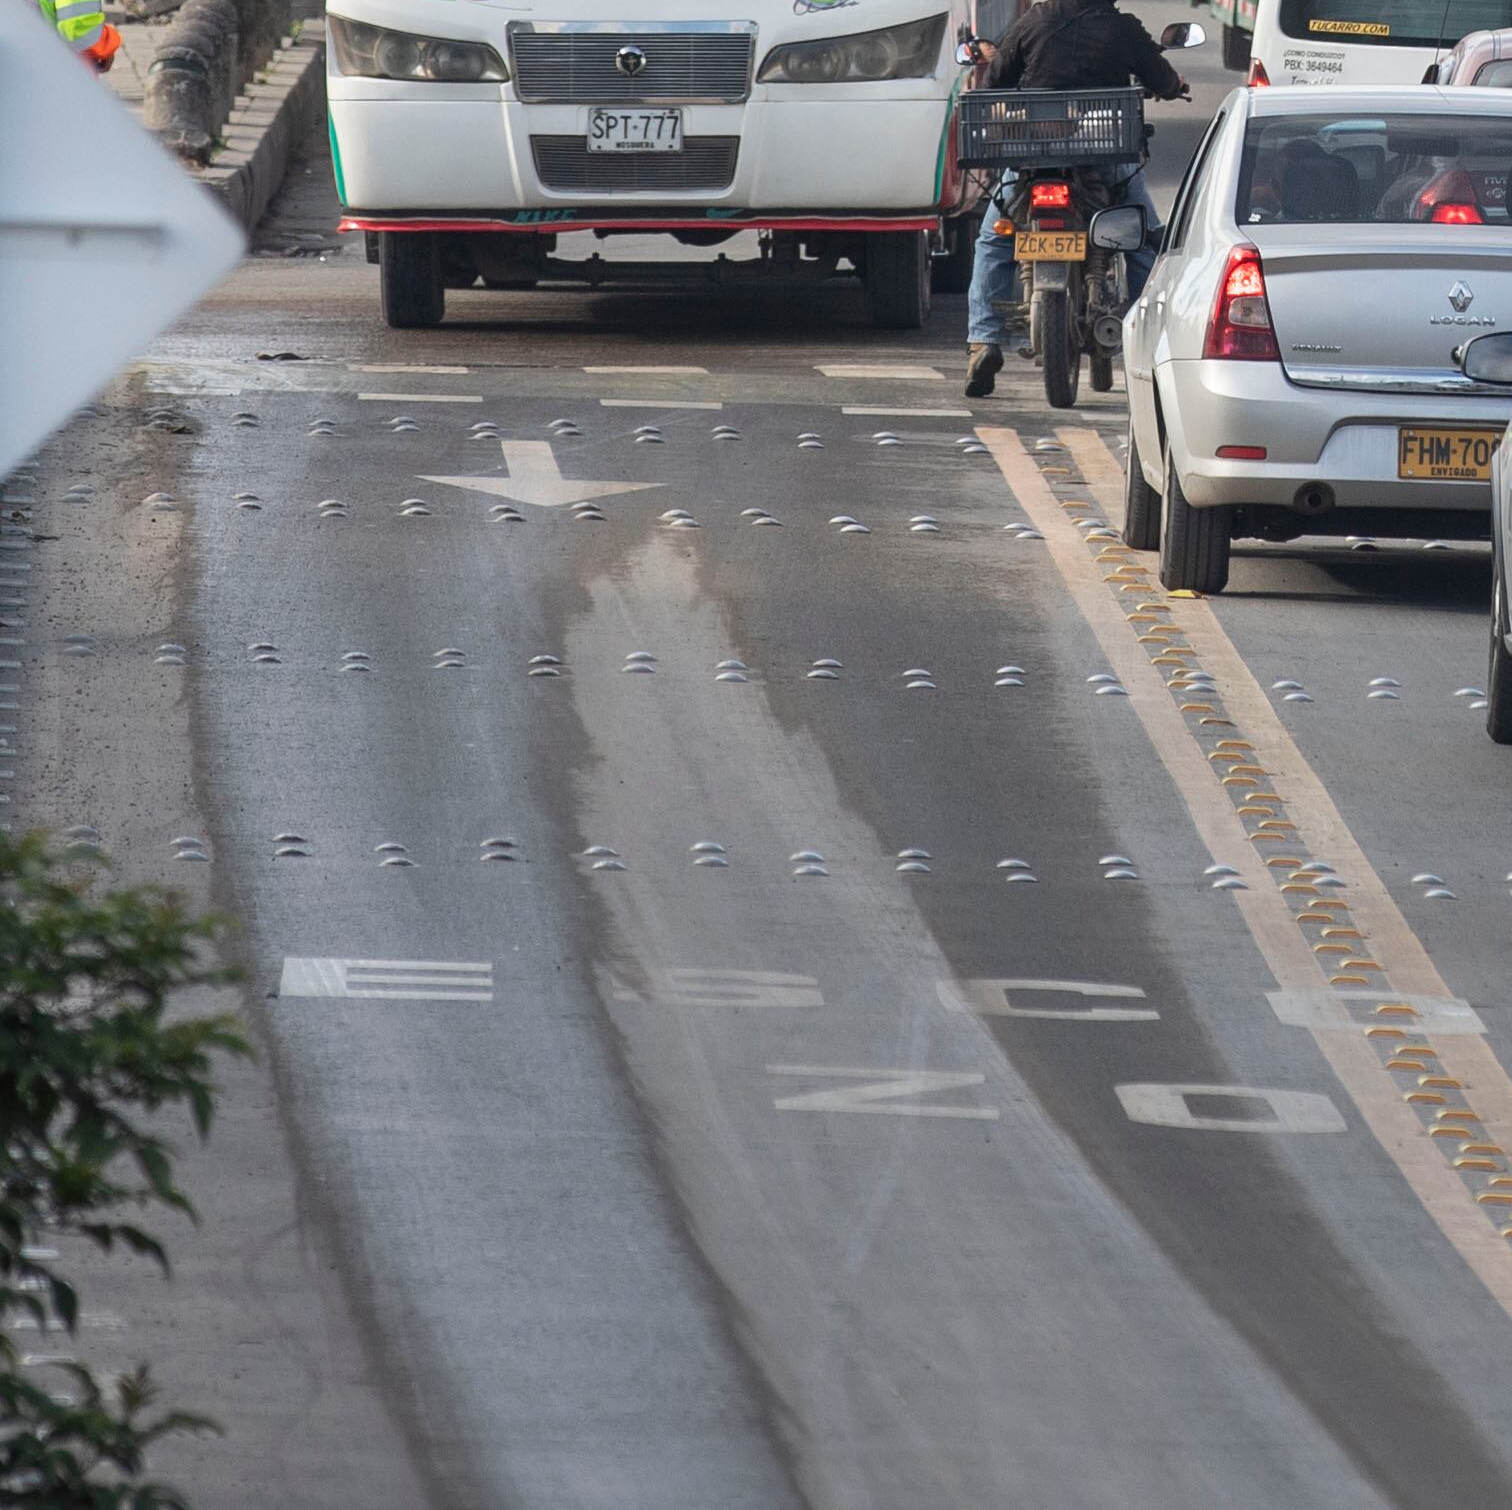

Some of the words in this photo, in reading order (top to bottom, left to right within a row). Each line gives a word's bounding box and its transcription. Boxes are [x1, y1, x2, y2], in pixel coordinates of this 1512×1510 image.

[1305, 61, 1343, 73] 3649464
[1430, 314, 1496, 326] LOGAN
[1431, 467, 1477, 477] ENVIGADO
